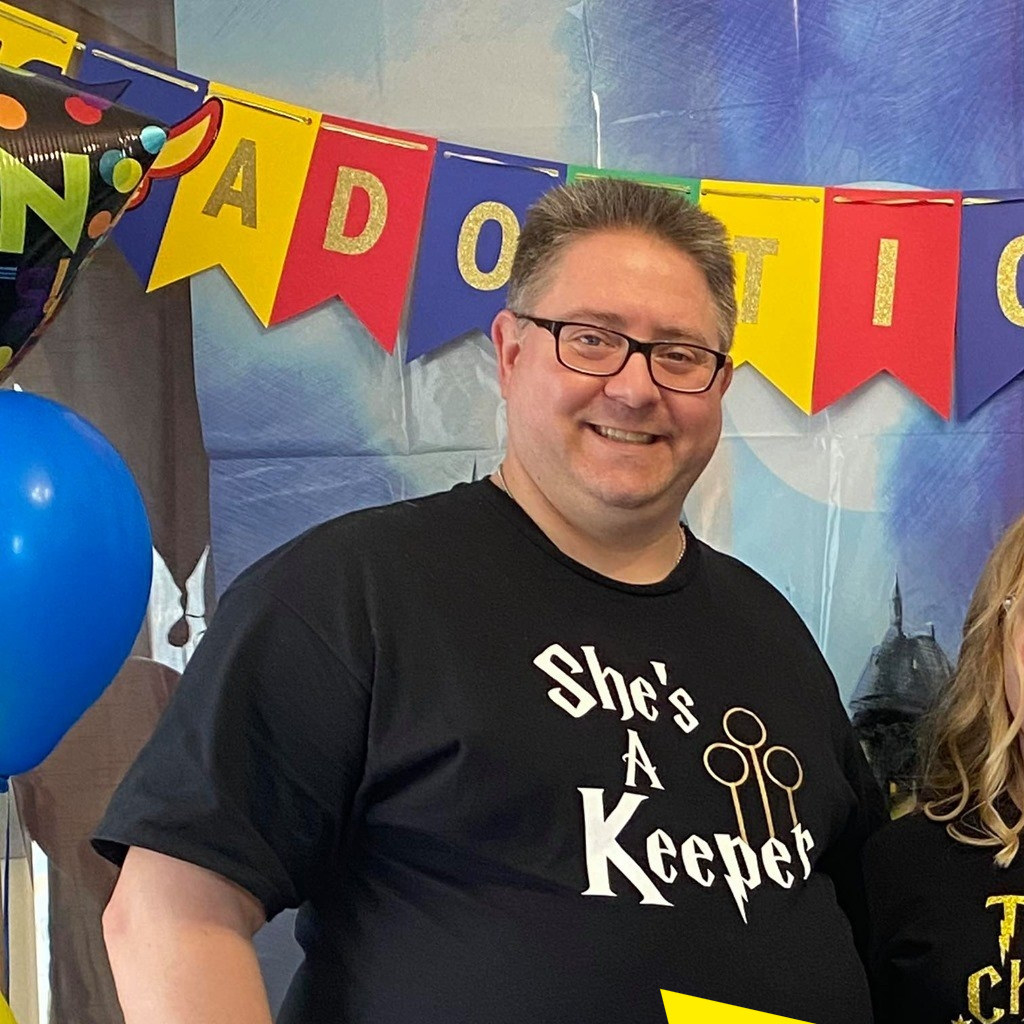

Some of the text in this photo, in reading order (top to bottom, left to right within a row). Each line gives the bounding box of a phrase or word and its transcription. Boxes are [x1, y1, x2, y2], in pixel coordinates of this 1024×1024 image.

[532, 642, 700, 734] She's
[621, 728, 666, 791] A
[576, 786, 815, 925] Keeper
